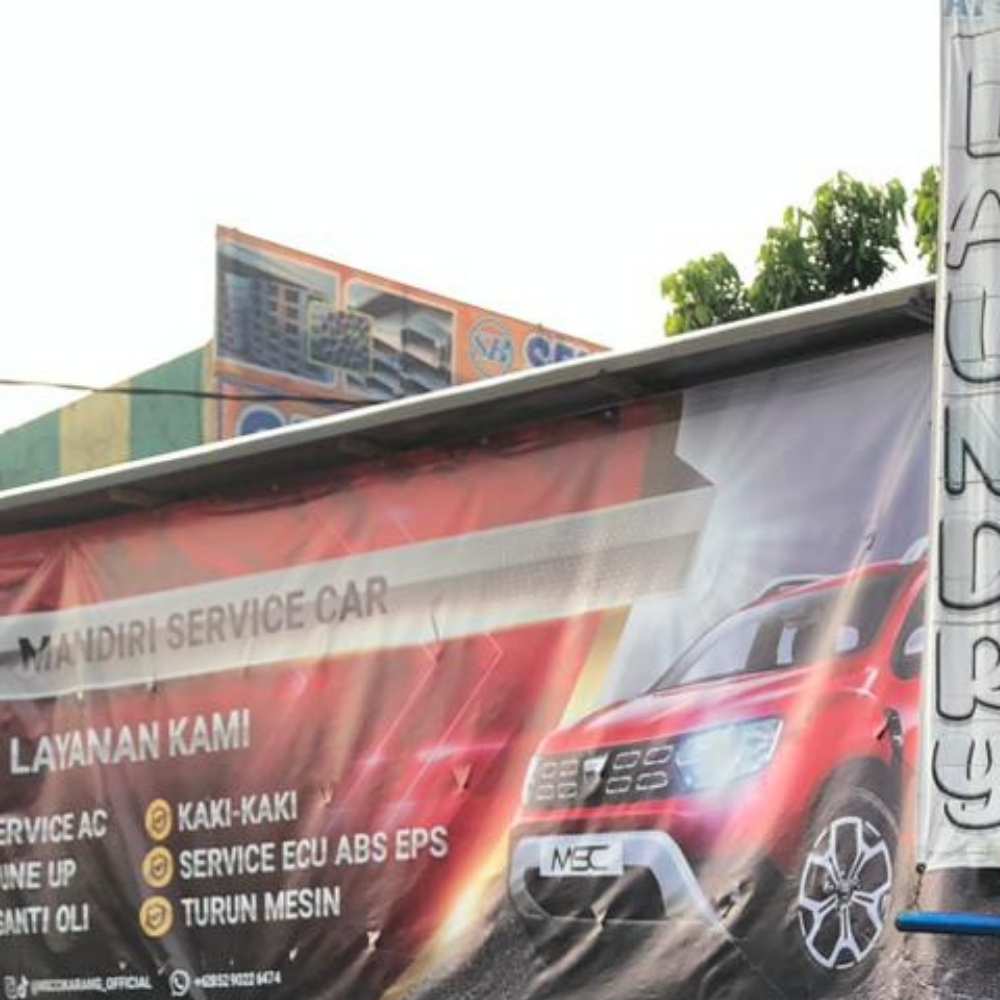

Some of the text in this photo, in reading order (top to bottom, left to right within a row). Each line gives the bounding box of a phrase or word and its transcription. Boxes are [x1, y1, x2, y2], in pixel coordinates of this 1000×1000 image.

[18, 575, 388, 672] MANDIRI SERVICE CAR
[10, 708, 250, 775] LAYANAN KAMI
[78, 809, 108, 840] AC
[178, 791, 297, 832] KAKI-KAKI
[48, 857, 77, 888] UP
[179, 826, 449, 880] SERVICE ECU ABS EPS
[56, 903, 89, 932] OLI
[180, 886, 341, 928] TURUN MESIN
